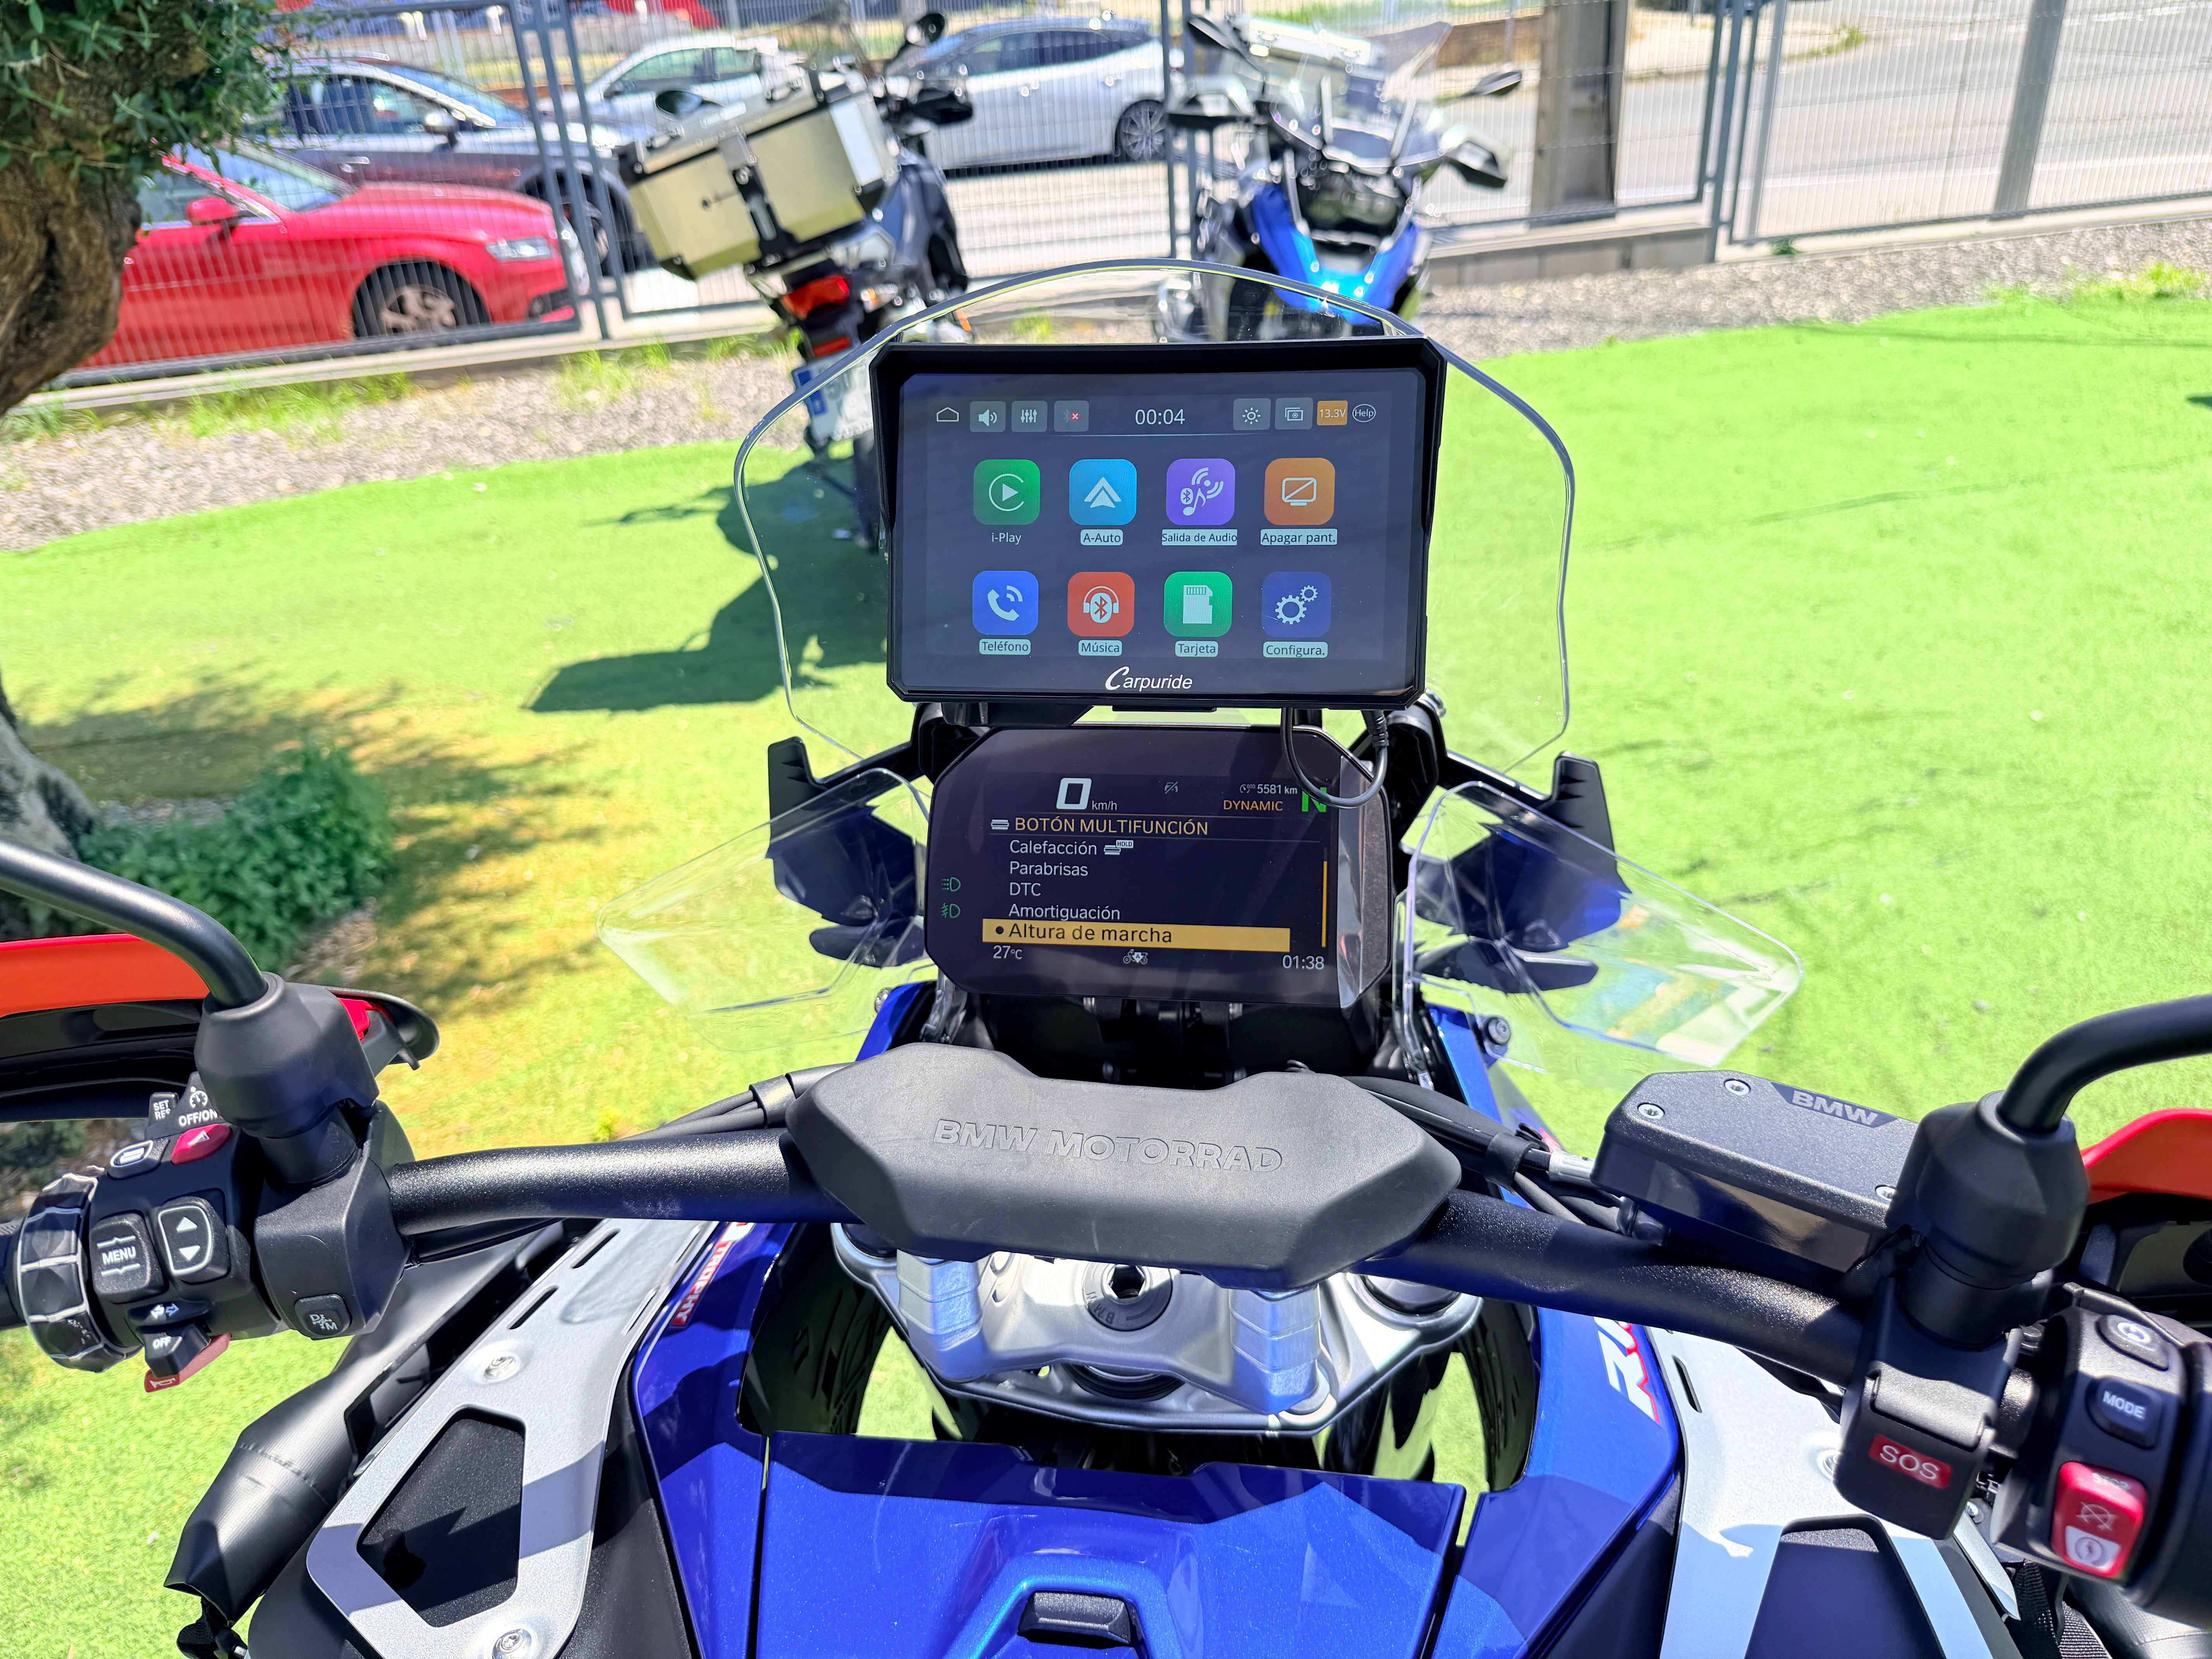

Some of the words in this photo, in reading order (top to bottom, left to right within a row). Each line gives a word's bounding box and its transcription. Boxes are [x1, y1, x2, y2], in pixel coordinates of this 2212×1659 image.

[1135, 409, 1185, 425] 00:04
[1319, 409, 1346, 418] 13.3V
[1355, 409, 1374, 419] Help
[992, 532, 1022, 545] i-Play
[1083, 533, 1121, 543] A-Auto
[1162, 533, 1190, 542] Salida
[1194, 533, 1206, 542] de
[1209, 533, 1237, 542] Audio
[1261, 533, 1303, 545] Apagar
[1306, 533, 1335, 545] pant.
[982, 641, 1029, 651] Teléfono
[1082, 641, 1120, 653] Música
[1178, 643, 1216, 656] Tarjeta
[1266, 645, 1325, 657] Configura.
[1105, 666, 1192, 692] Carpuride
[1056, 778, 1092, 810] 0
[1092, 800, 1117, 811] km/h
[1257, 784, 1281, 794] 5581
[1284, 785, 1298, 794] km
[1223, 800, 1283, 811] DYNAMIC
[1302, 787, 1327, 812] N
[1015, 816, 1074, 832] BOTÓN
[1080, 818, 1208, 835] MULTIFUNCIÓN
[1010, 840, 1097, 855] Calefacción
[1010, 861, 1088, 876] Parabrisas
[1010, 882, 1041, 896] DTC
[1009, 904, 1121, 921] Amortiguación
[1008, 923, 1065, 939] Altura
[1072, 925, 1095, 940] de
[1102, 927, 1172, 943] marcha
[1283, 955, 1324, 970] 01:38
[153, 1099, 169, 1111] SET
[1792, 1090, 1879, 1125] BMW
[179, 1109, 218, 1126] OFF/ON
[933, 1119, 1038, 1152] BMW
[1045, 1130, 1283, 1173] MOTORRAD
[102, 1245, 137, 1265] MENU
[677, 1241, 733, 1321] TROPHY
[153, 1336, 172, 1350] OFF
[1593, 1316, 1660, 1425] R1
[2103, 1390, 2146, 1420] MODE
[1879, 1444, 1940, 1481] SOS
